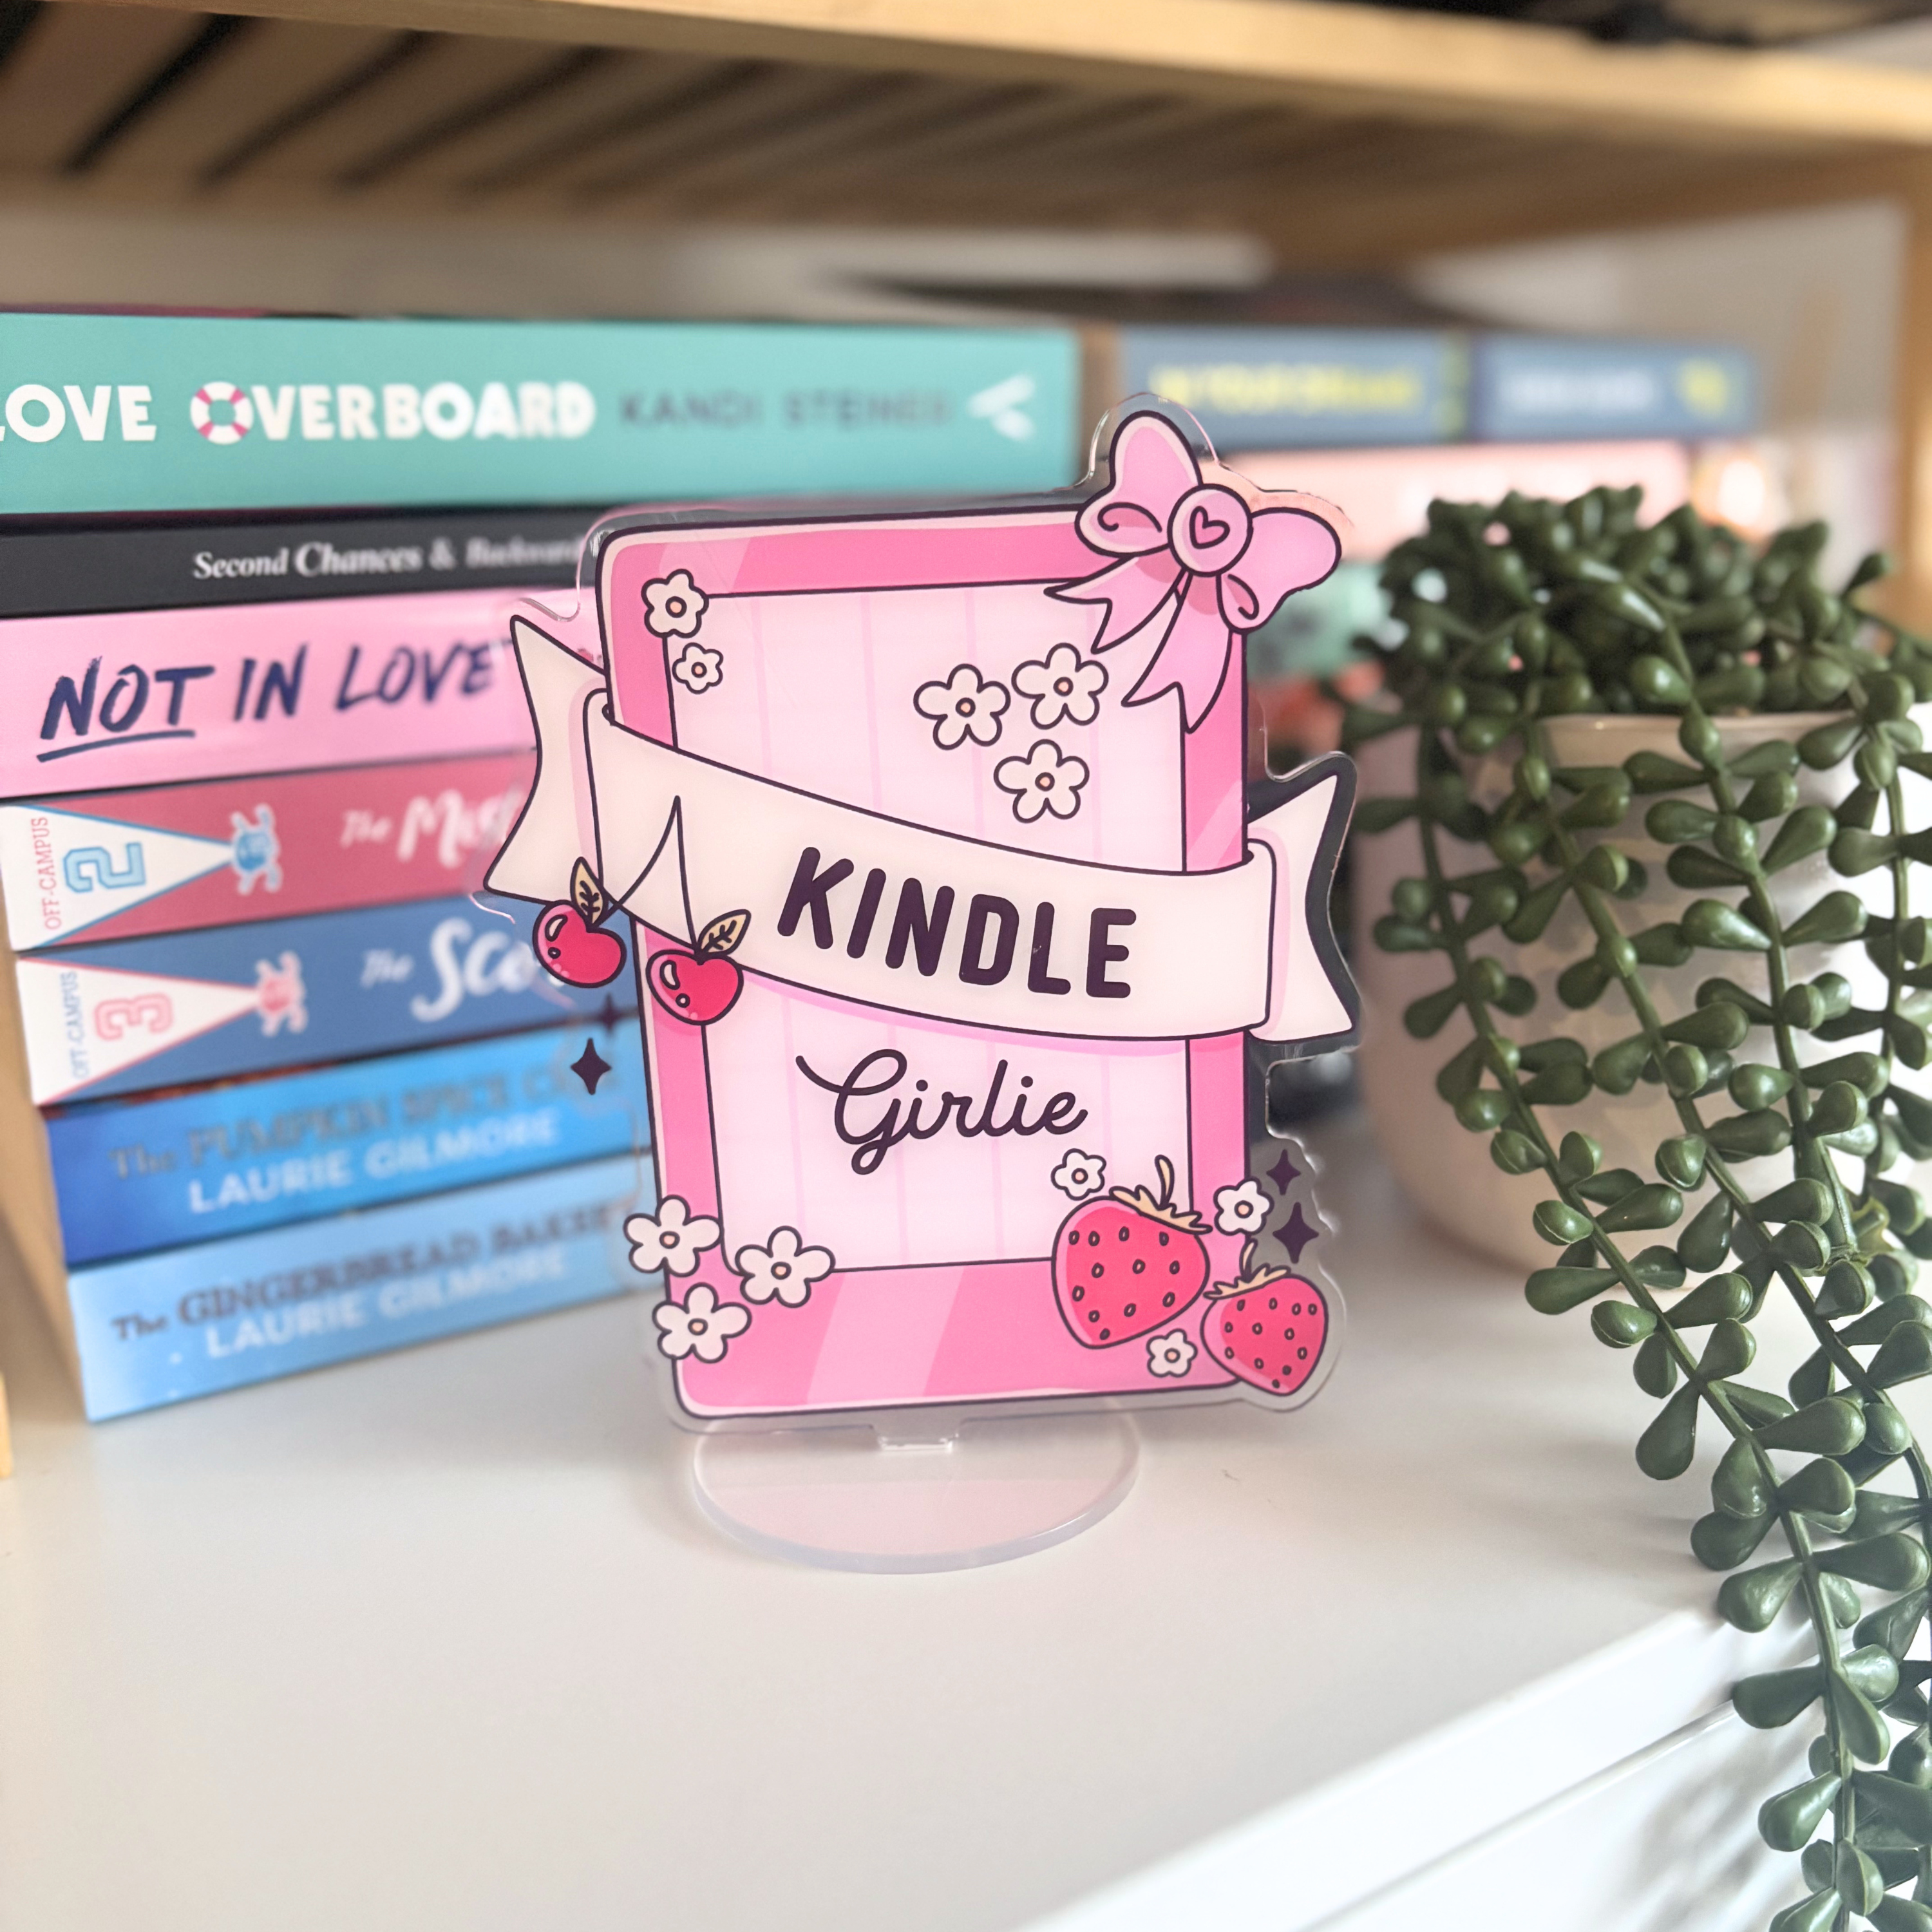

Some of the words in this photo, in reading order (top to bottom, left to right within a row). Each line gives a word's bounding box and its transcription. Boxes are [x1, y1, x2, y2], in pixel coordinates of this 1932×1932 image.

[0, 384, 156, 442] OVE
[190, 381, 596, 445] OVERBOARD
[193, 549, 289, 579] Second
[295, 540, 422, 578] Chances
[428, 537, 456, 571] &
[40, 656, 215, 741] NOT
[234, 643, 308, 722] IN
[335, 640, 514, 711] LOVE
[31, 817, 62, 931] OFF-CAMPUS
[62, 842, 147, 893] 2
[777, 847, 1137, 999] KINDLE
[93, 992, 173, 1041] 3
[795, 1048, 1088, 1175] Girlie
[189, 1148, 354, 1213] LAURIE
[111, 1312, 170, 1341] The
[207, 1291, 365, 1359] LAURIE
